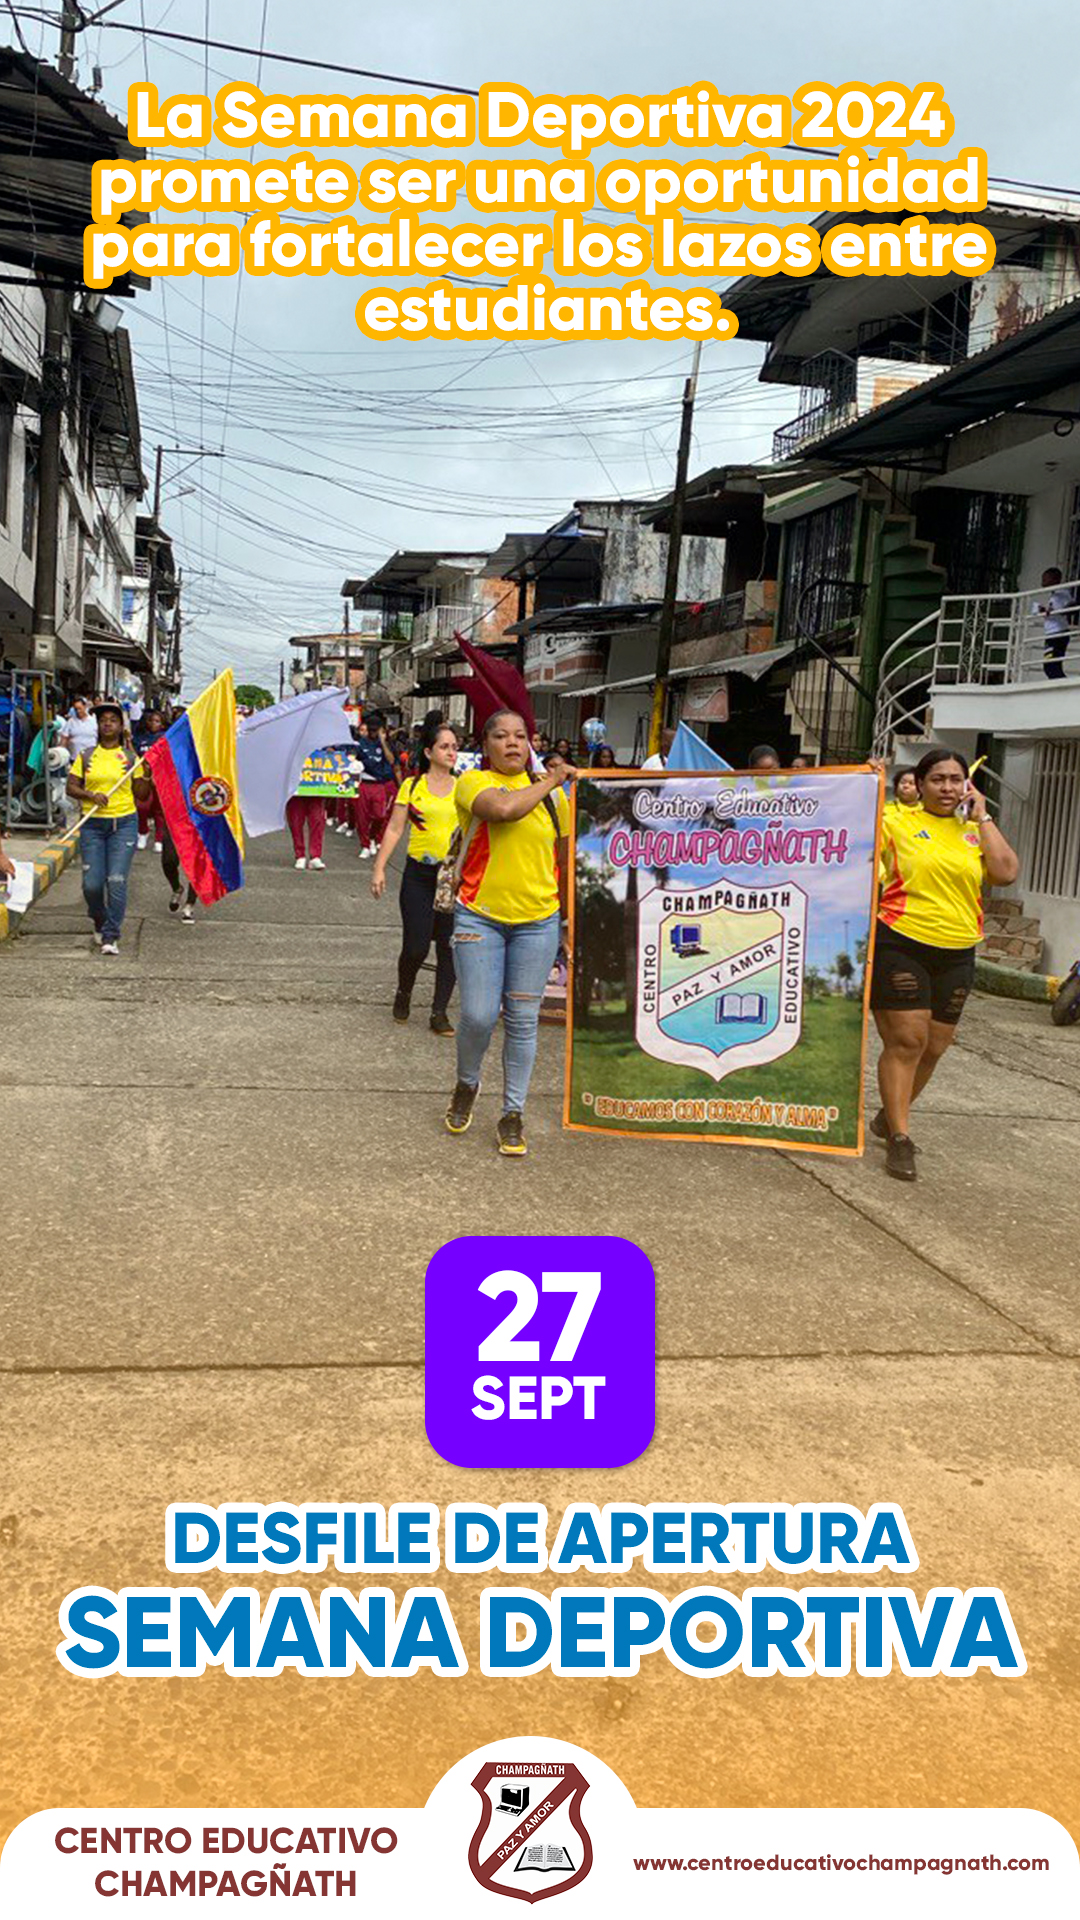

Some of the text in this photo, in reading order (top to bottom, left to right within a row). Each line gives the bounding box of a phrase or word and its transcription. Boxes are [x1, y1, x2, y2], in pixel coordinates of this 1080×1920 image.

[633, 787, 819, 821] Centro Educativo
[643, 943, 657, 1014] CENTRO
[671, 943, 777, 1007] PAZ Y AMOR
[784, 927, 801, 1024] EDUCATIVO
[676, 1101, 704, 1121] CON
[707, 1097, 773, 1124] CORAZÓN
[776, 1104, 787, 1125] Y
[789, 1105, 827, 1129] ALMA
